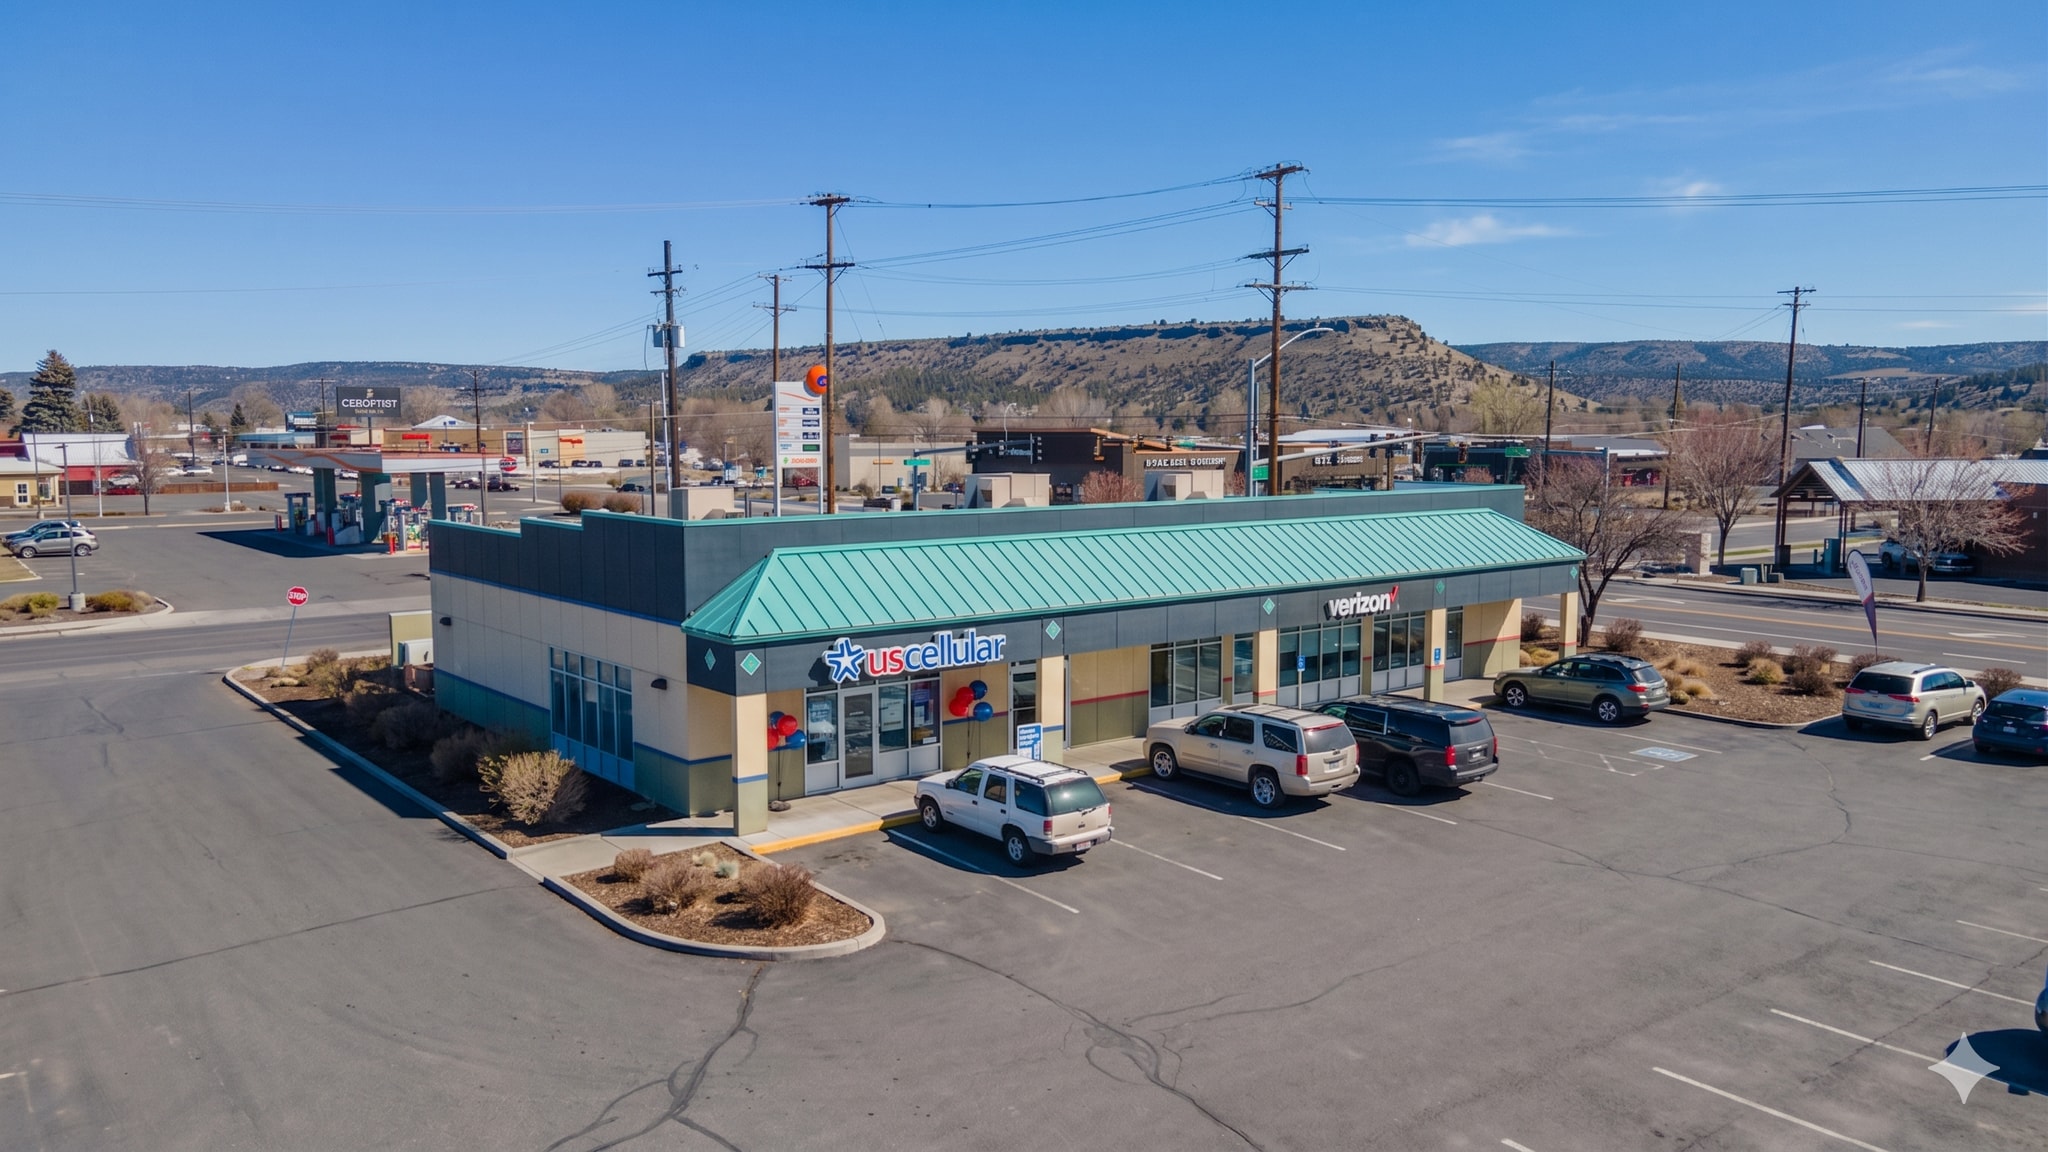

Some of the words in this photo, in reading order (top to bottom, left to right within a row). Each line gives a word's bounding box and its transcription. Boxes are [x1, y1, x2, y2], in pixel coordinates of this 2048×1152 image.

[288, 591, 307, 601] STOP
[1327, 591, 1391, 617] verizon
[866, 629, 1006, 677] uscellular
